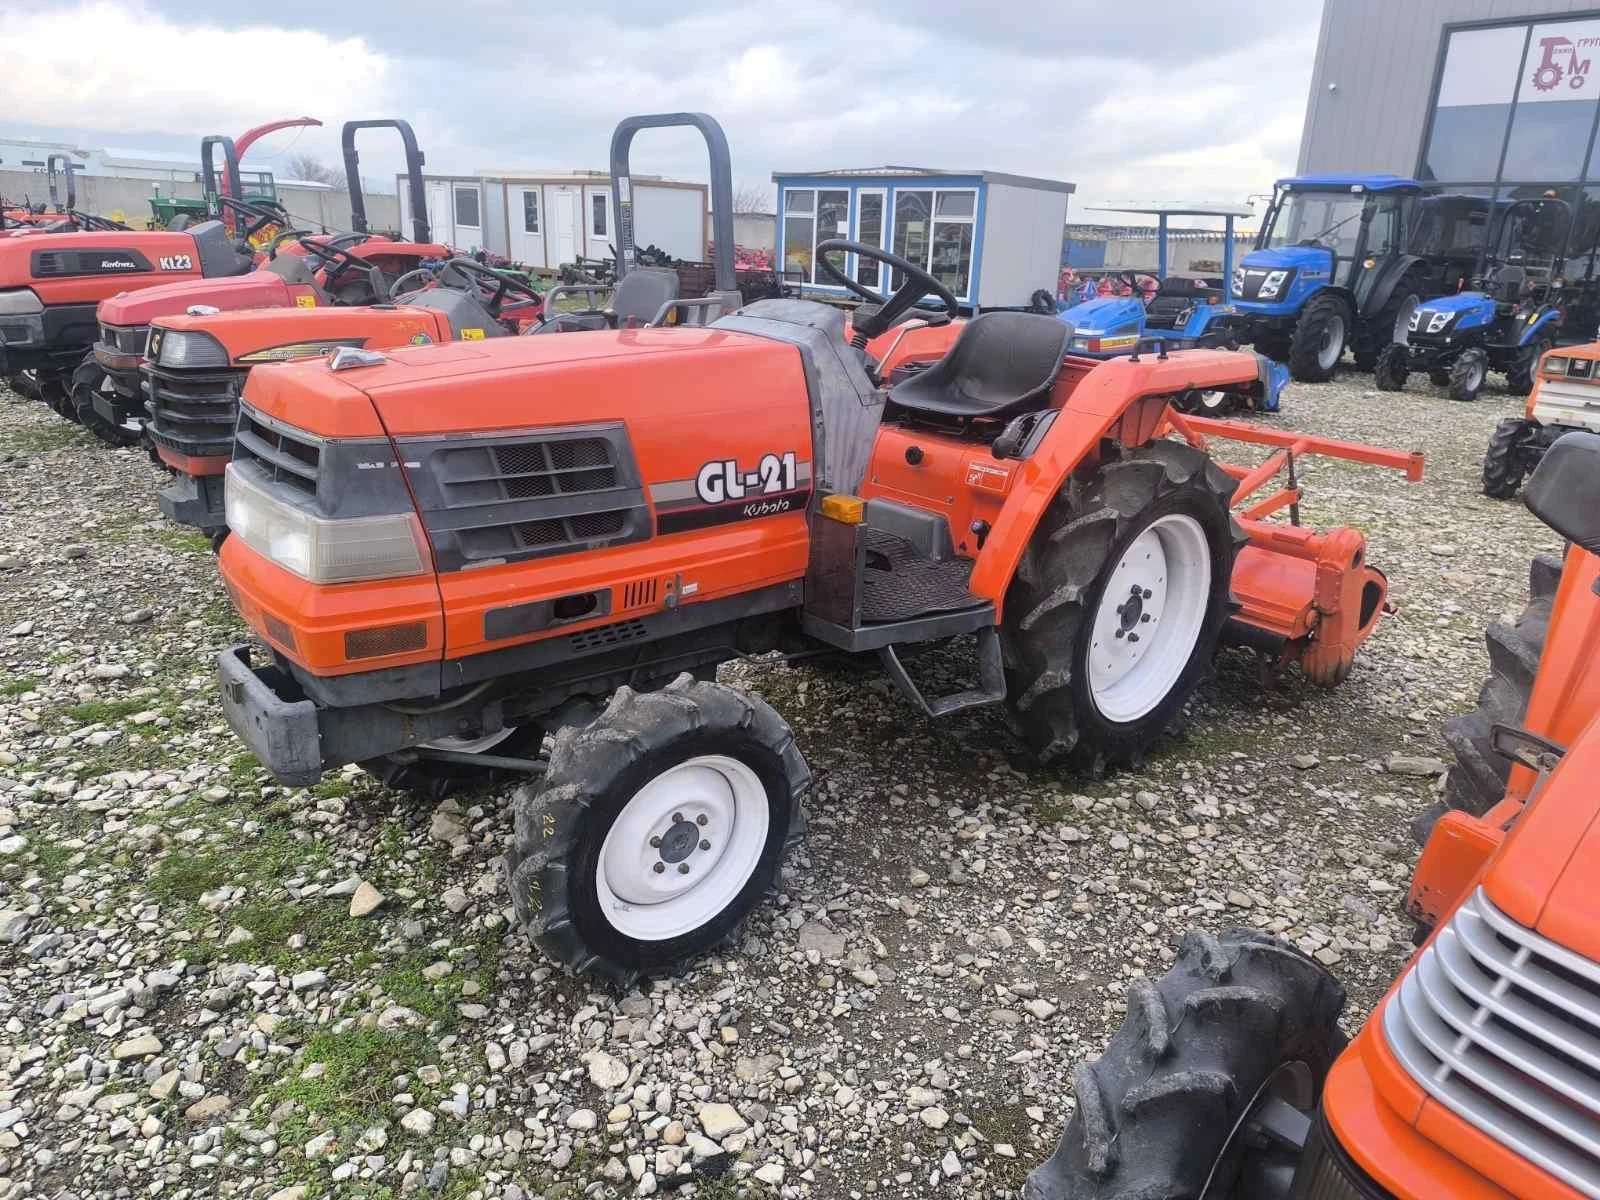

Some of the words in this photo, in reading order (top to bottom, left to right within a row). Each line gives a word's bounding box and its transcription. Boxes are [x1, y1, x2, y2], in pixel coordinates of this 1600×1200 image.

[159, 255, 193, 271] KL23
[695, 451, 797, 506] GL-21
[743, 500, 790, 517] Kubota
